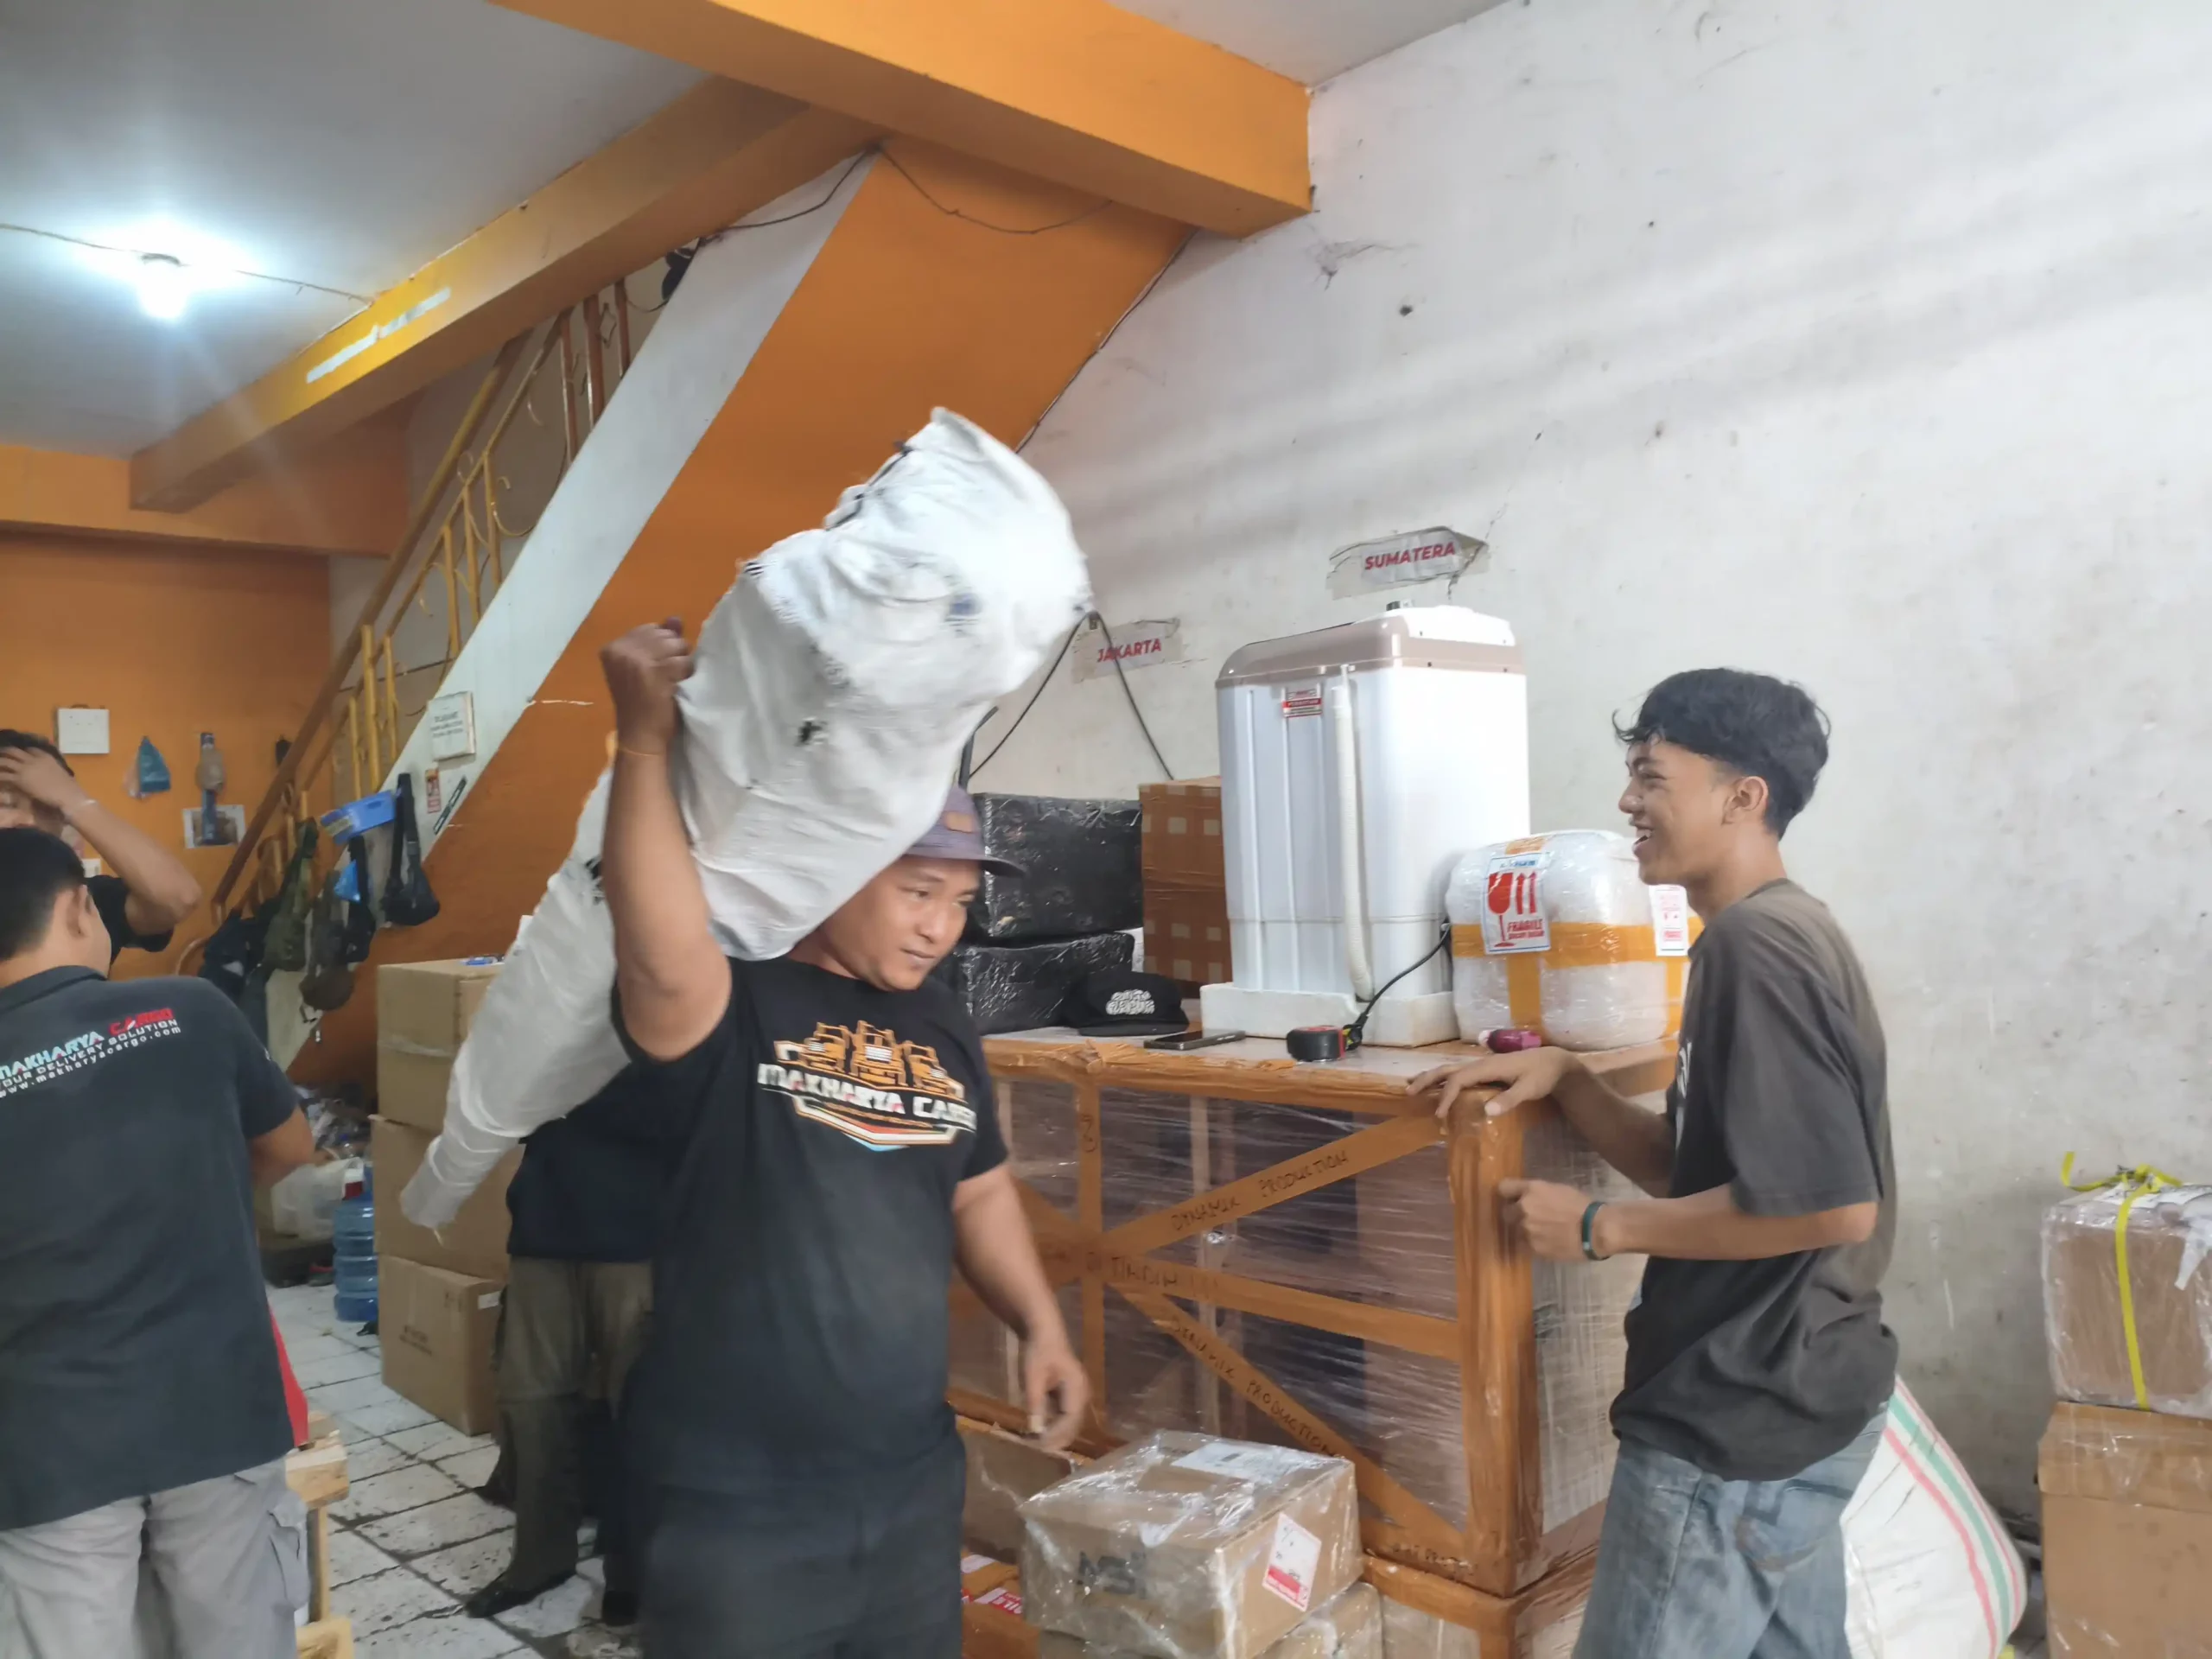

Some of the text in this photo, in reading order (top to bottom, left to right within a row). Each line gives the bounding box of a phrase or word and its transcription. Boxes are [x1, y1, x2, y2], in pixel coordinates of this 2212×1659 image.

[1364, 541, 1456, 570] SUMATERA
[1097, 638, 1162, 663] JAKARTA
[0, 1031, 105, 1080] MAKHARYA
[0, 1027, 181, 1098] www.makharyacargo.com
[36, 1043, 104, 1075] DELIVERY
[108, 1019, 178, 1046] SOLUTION
[757, 1063, 906, 1115] MAKHARYA
